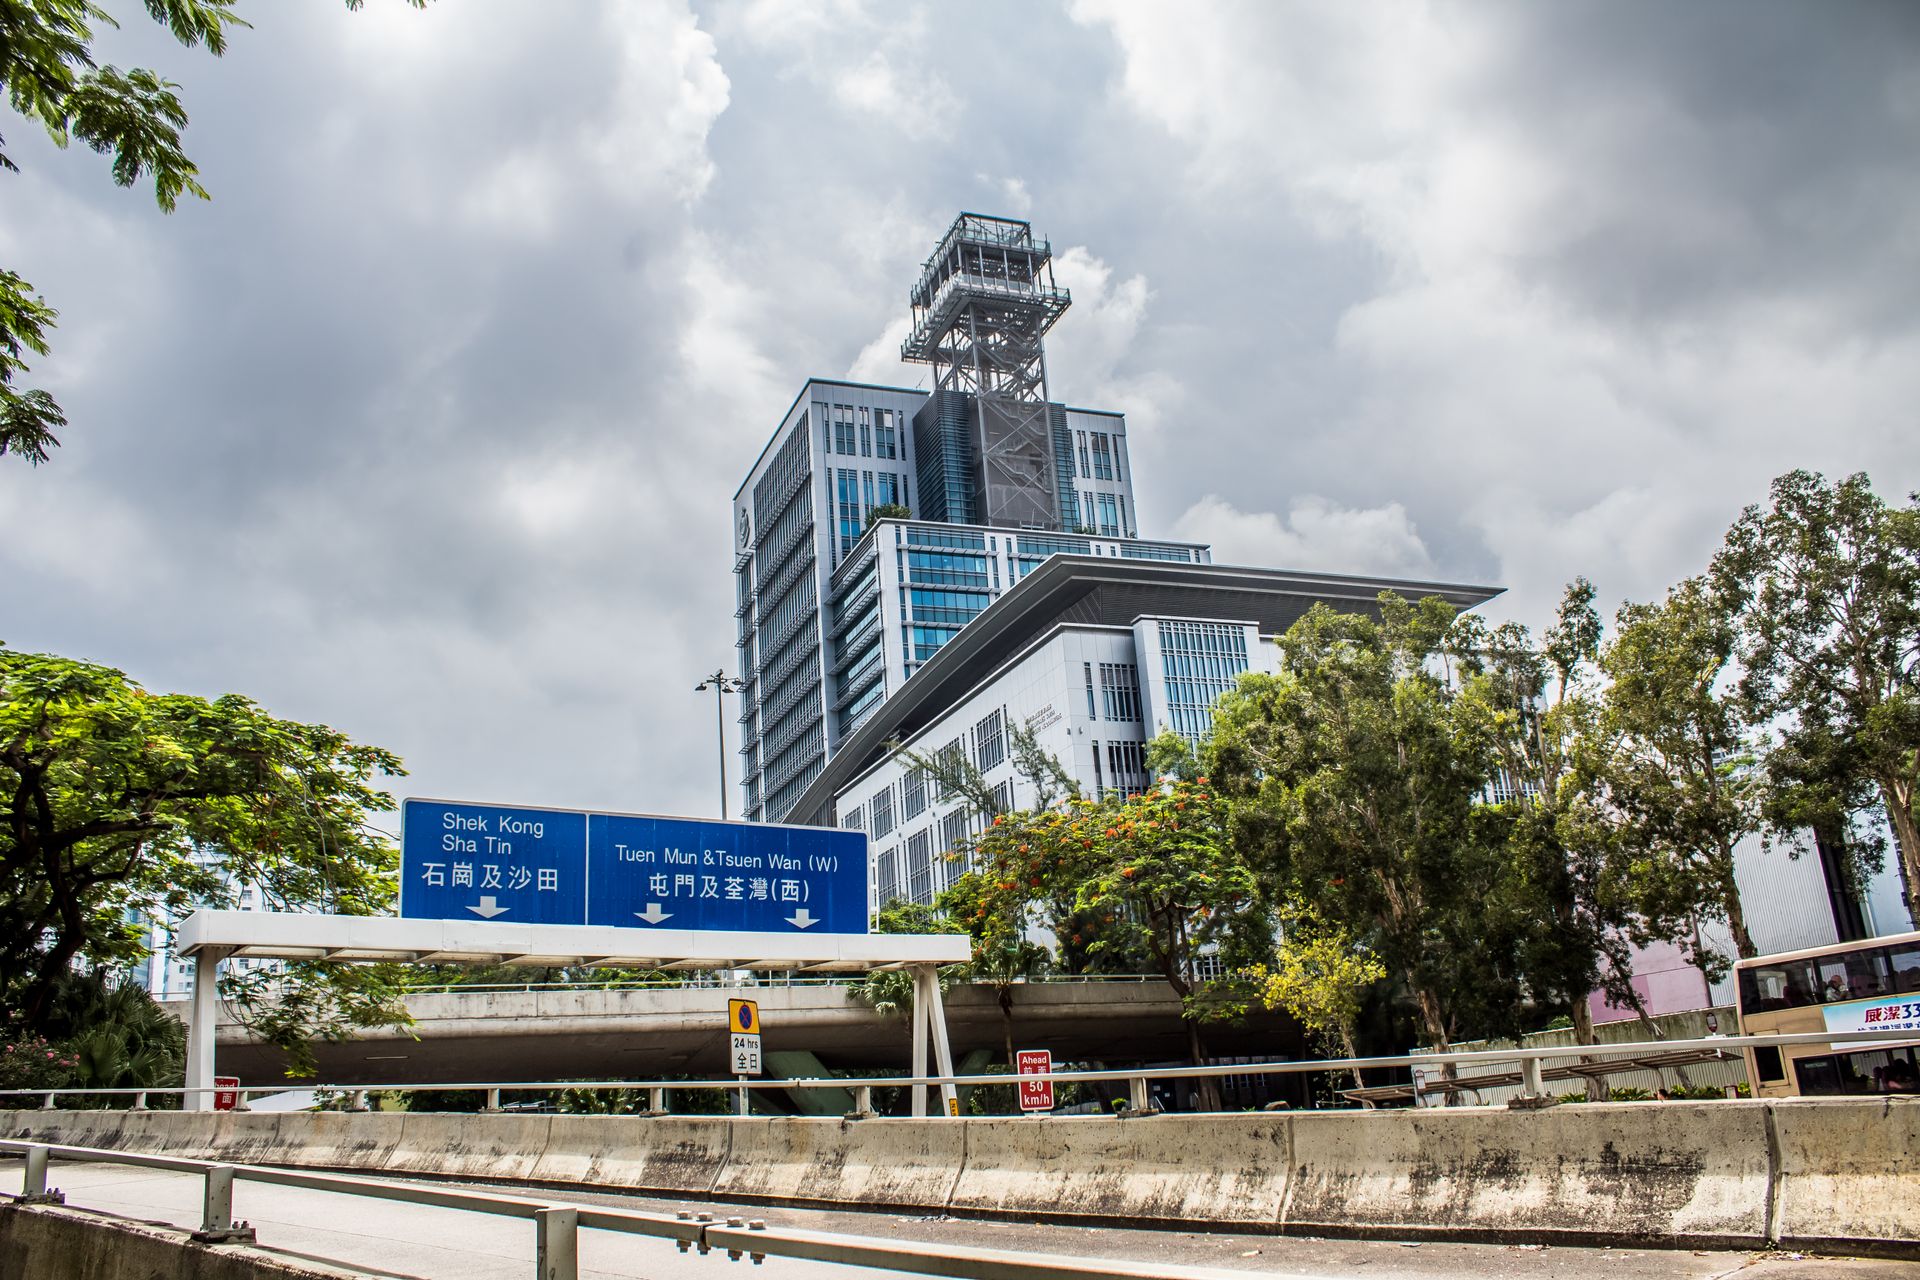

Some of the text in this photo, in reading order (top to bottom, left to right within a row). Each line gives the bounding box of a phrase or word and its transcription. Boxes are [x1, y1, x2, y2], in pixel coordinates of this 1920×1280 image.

[442, 812, 544, 839] Shek Kong
[442, 834, 512, 855] Sha Tin
[615, 844, 655, 863] Tuen
[664, 847, 698, 865] Mun
[768, 853, 801, 871] Wan
[808, 855, 839, 873] (W)
[421, 861, 558, 892] 石崗及沙田
[734, 1037, 759, 1049] 24 hrs
[737, 1052, 757, 1069] 全日
[1022, 1055, 1047, 1065] Ahead
[1029, 1080, 1044, 1092] 50
[1024, 1093, 1050, 1105] km/h
